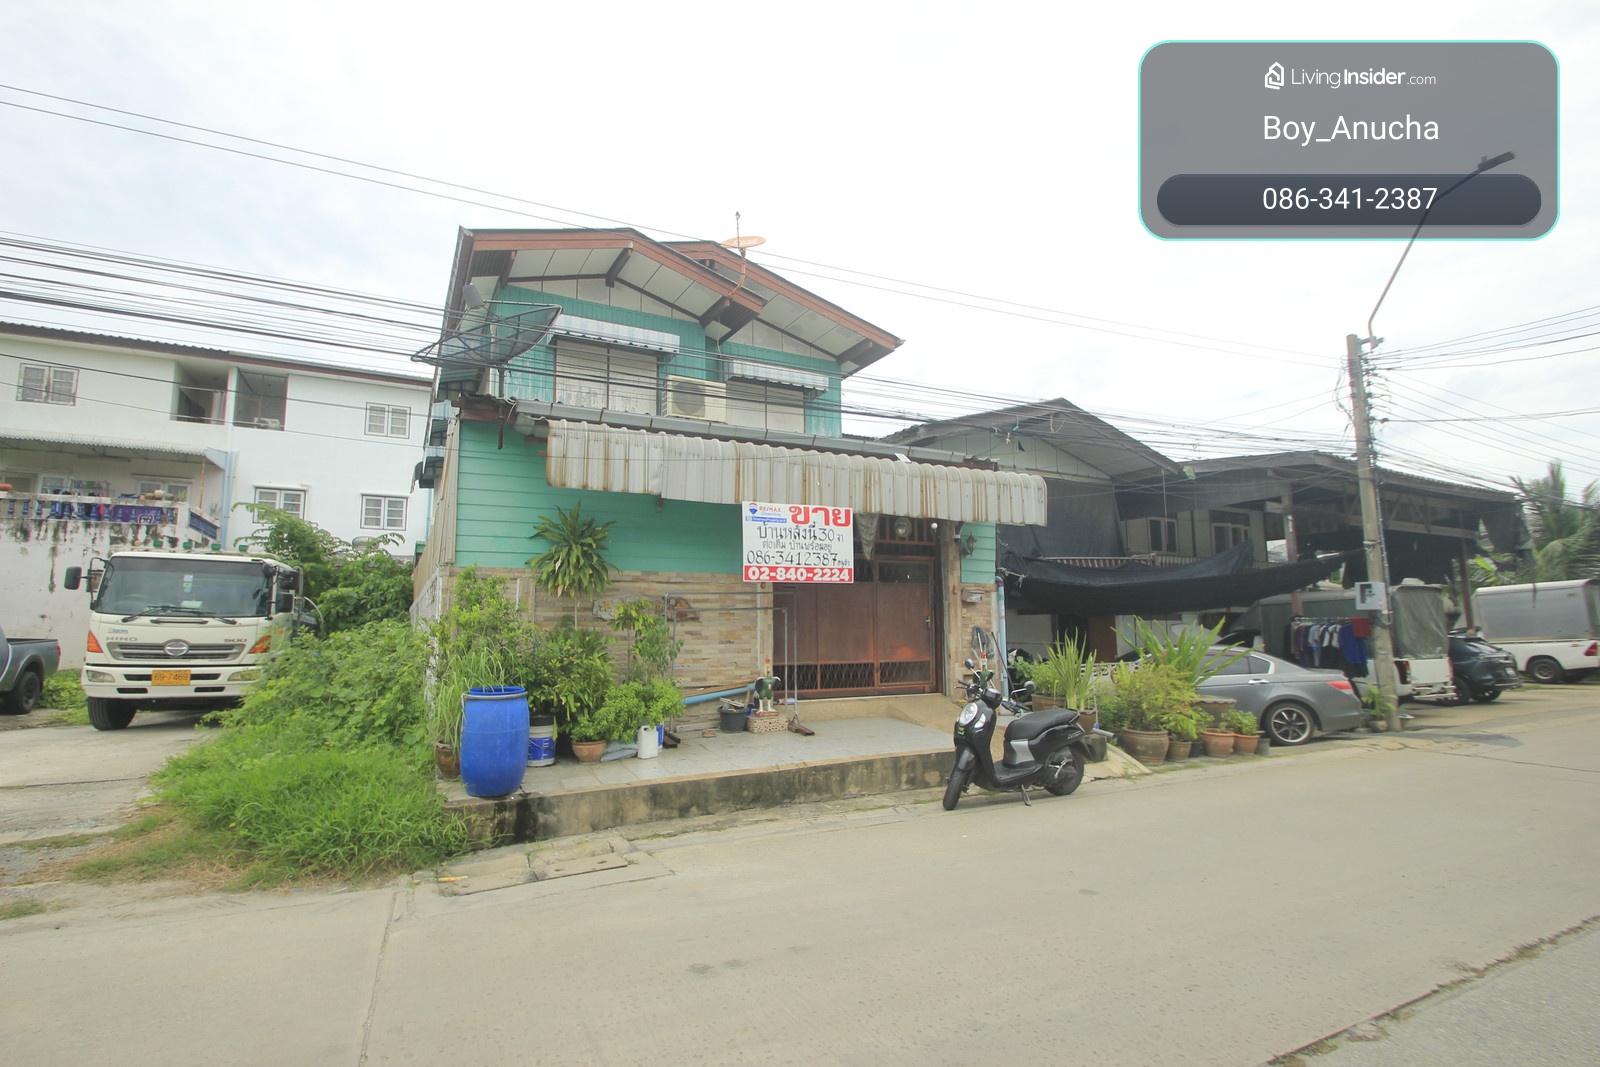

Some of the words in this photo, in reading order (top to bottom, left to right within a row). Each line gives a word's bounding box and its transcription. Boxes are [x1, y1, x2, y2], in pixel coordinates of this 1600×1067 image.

[758, 505, 782, 513] RE/MAX
[788, 505, 851, 527] ขาย
[746, 550, 838, 567] 086-3412387
[747, 566, 850, 582] 02-840-2224
